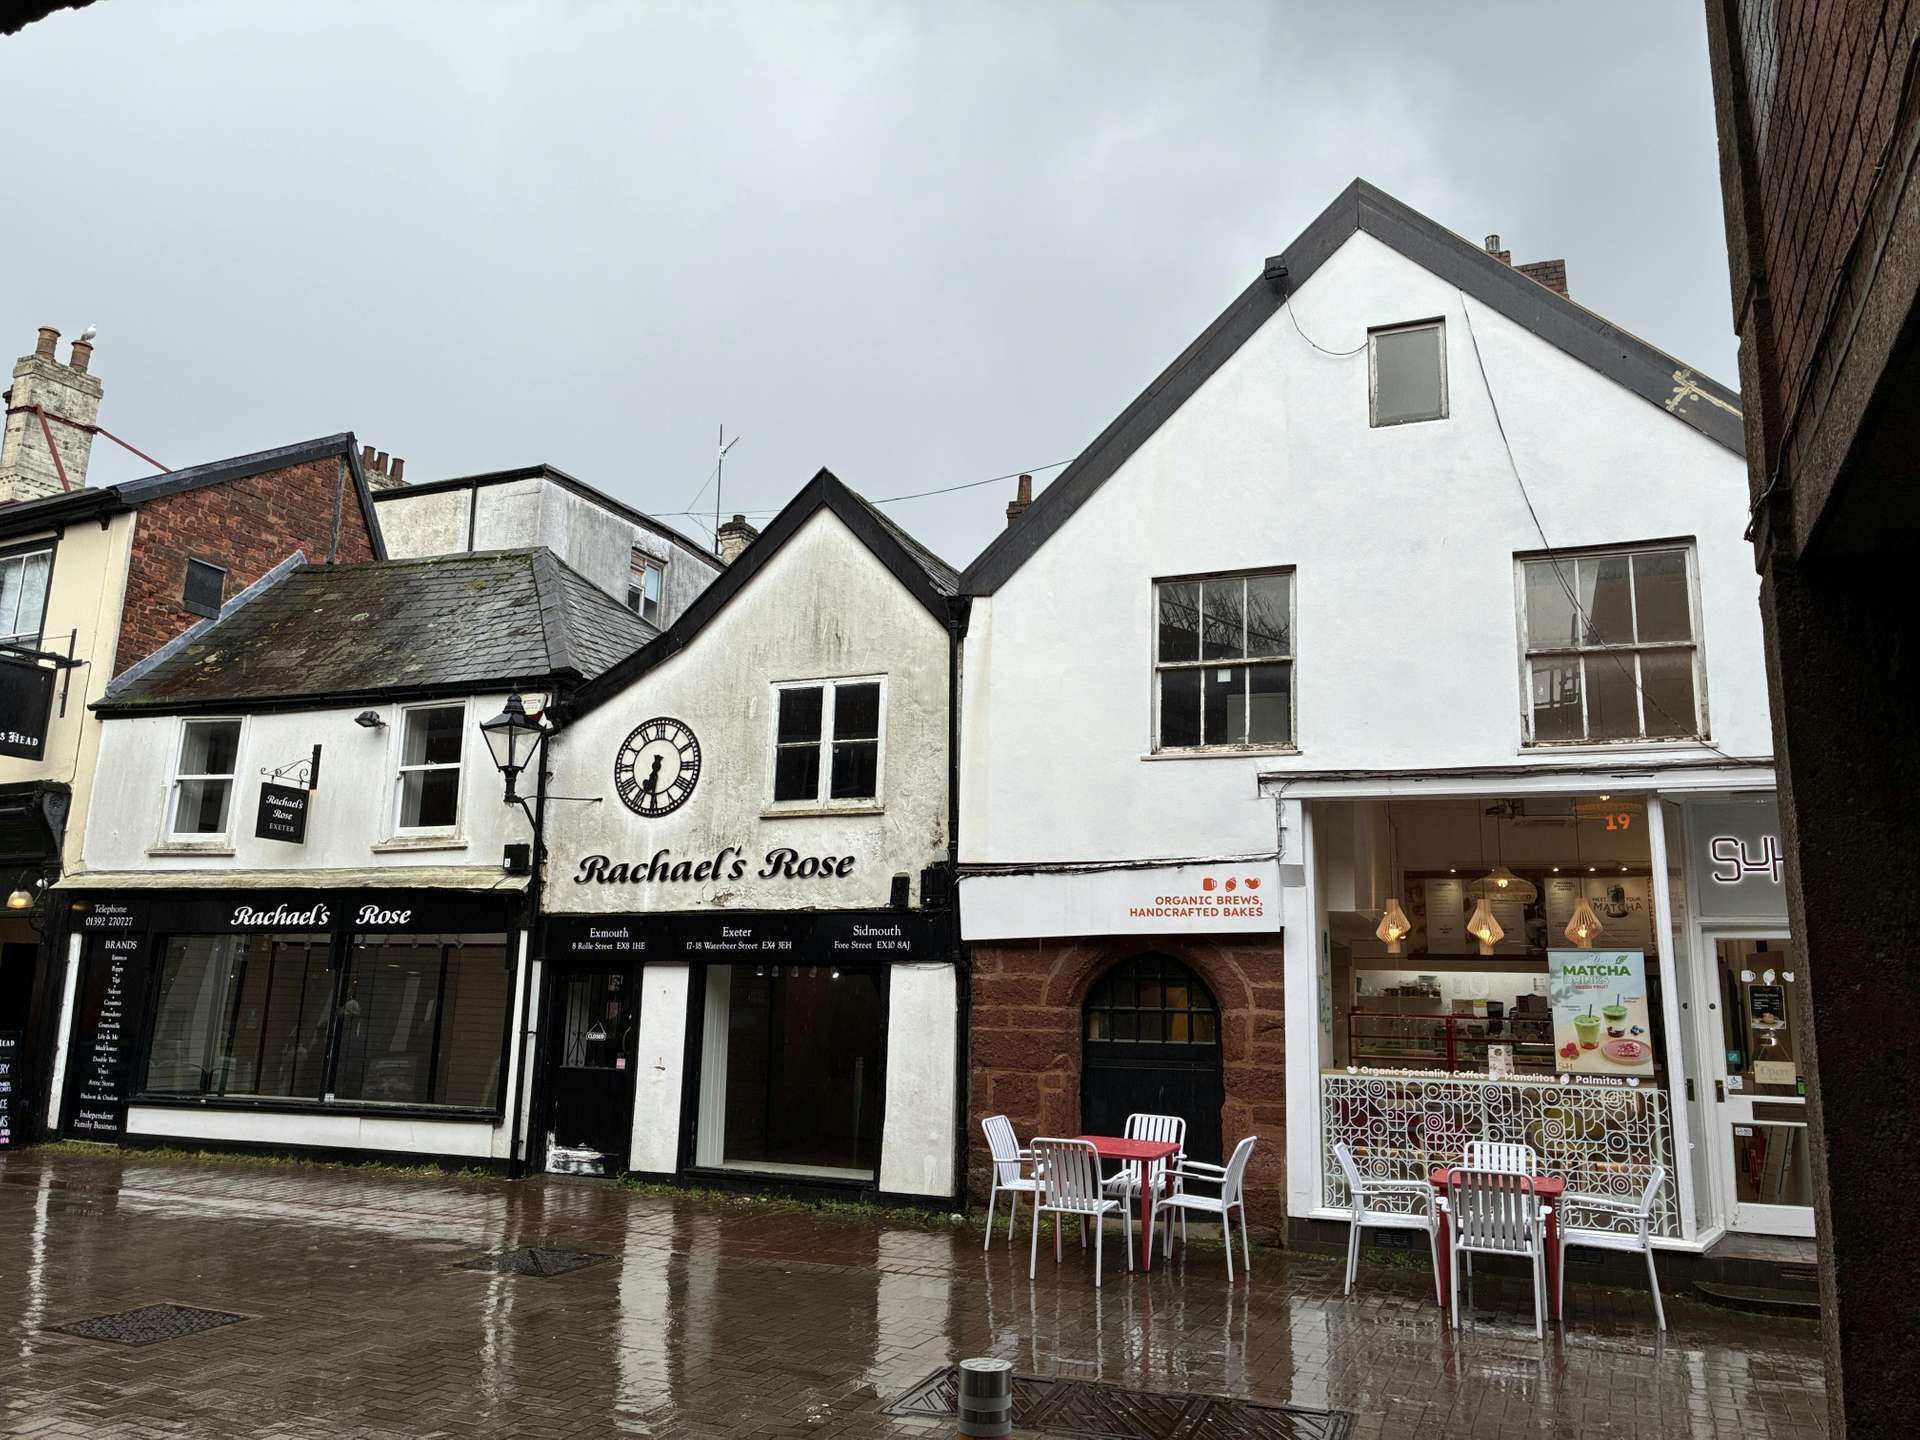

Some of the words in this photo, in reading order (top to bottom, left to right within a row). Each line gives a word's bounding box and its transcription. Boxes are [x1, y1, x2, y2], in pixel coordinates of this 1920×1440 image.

[266, 794, 304, 809] Rachael's
[272, 808, 293, 820] Rose
[270, 822, 295, 832] EXETER
[1604, 813, 1630, 830] 19
[574, 845, 747, 886] Rachael's
[758, 848, 856, 881] Rose
[1155, 896, 1212, 906] ORGANIC
[1217, 895, 1263, 906] BREWS,
[95, 904, 127, 915] Telephone
[1130, 907, 1219, 917] HANDCRAFTED
[1223, 907, 1263, 917] BAKES
[1593, 902, 1643, 912] MATCHA
[230, 904, 330, 926] Rachael's
[356, 904, 412, 925] Rose
[85, 917, 106, 926] 01392
[108, 917, 133, 926] 270727
[590, 927, 629, 938] Exmouth
[722, 926, 752, 937] Exeter
[853, 925, 902, 936] Sidmouth
[105, 940, 138, 950] BRANDS
[572, 942, 577, 950] 8
[578, 942, 594, 950] Rolle
[595, 942, 613, 950] Street
[617, 942, 630, 950] EX8
[704, 942, 737, 950] Waterbeer
[738, 941, 758, 950] Street
[762, 941, 776, 949] EX4
[778, 941, 792, 950] 3EH
[834, 941, 850, 949] Fore
[851, 941, 872, 949] Street
[877, 941, 896, 949] EX10
[897, 941, 911, 951] 8AJ
[1563, 965, 1632, 976] MATCHA
[1360, 1066, 1398, 1076] Organic
[1402, 1068, 1450, 1079] Speciality
[1453, 1070, 1485, 1079] Coffee
[1504, 1073, 1555, 1083] Manolitos
[1576, 1076, 1623, 1086] Palmitas
[80, 1109, 114, 1120] Independent
[74, 1119, 92, 1130] Family
[94, 1121, 117, 1131] Business
